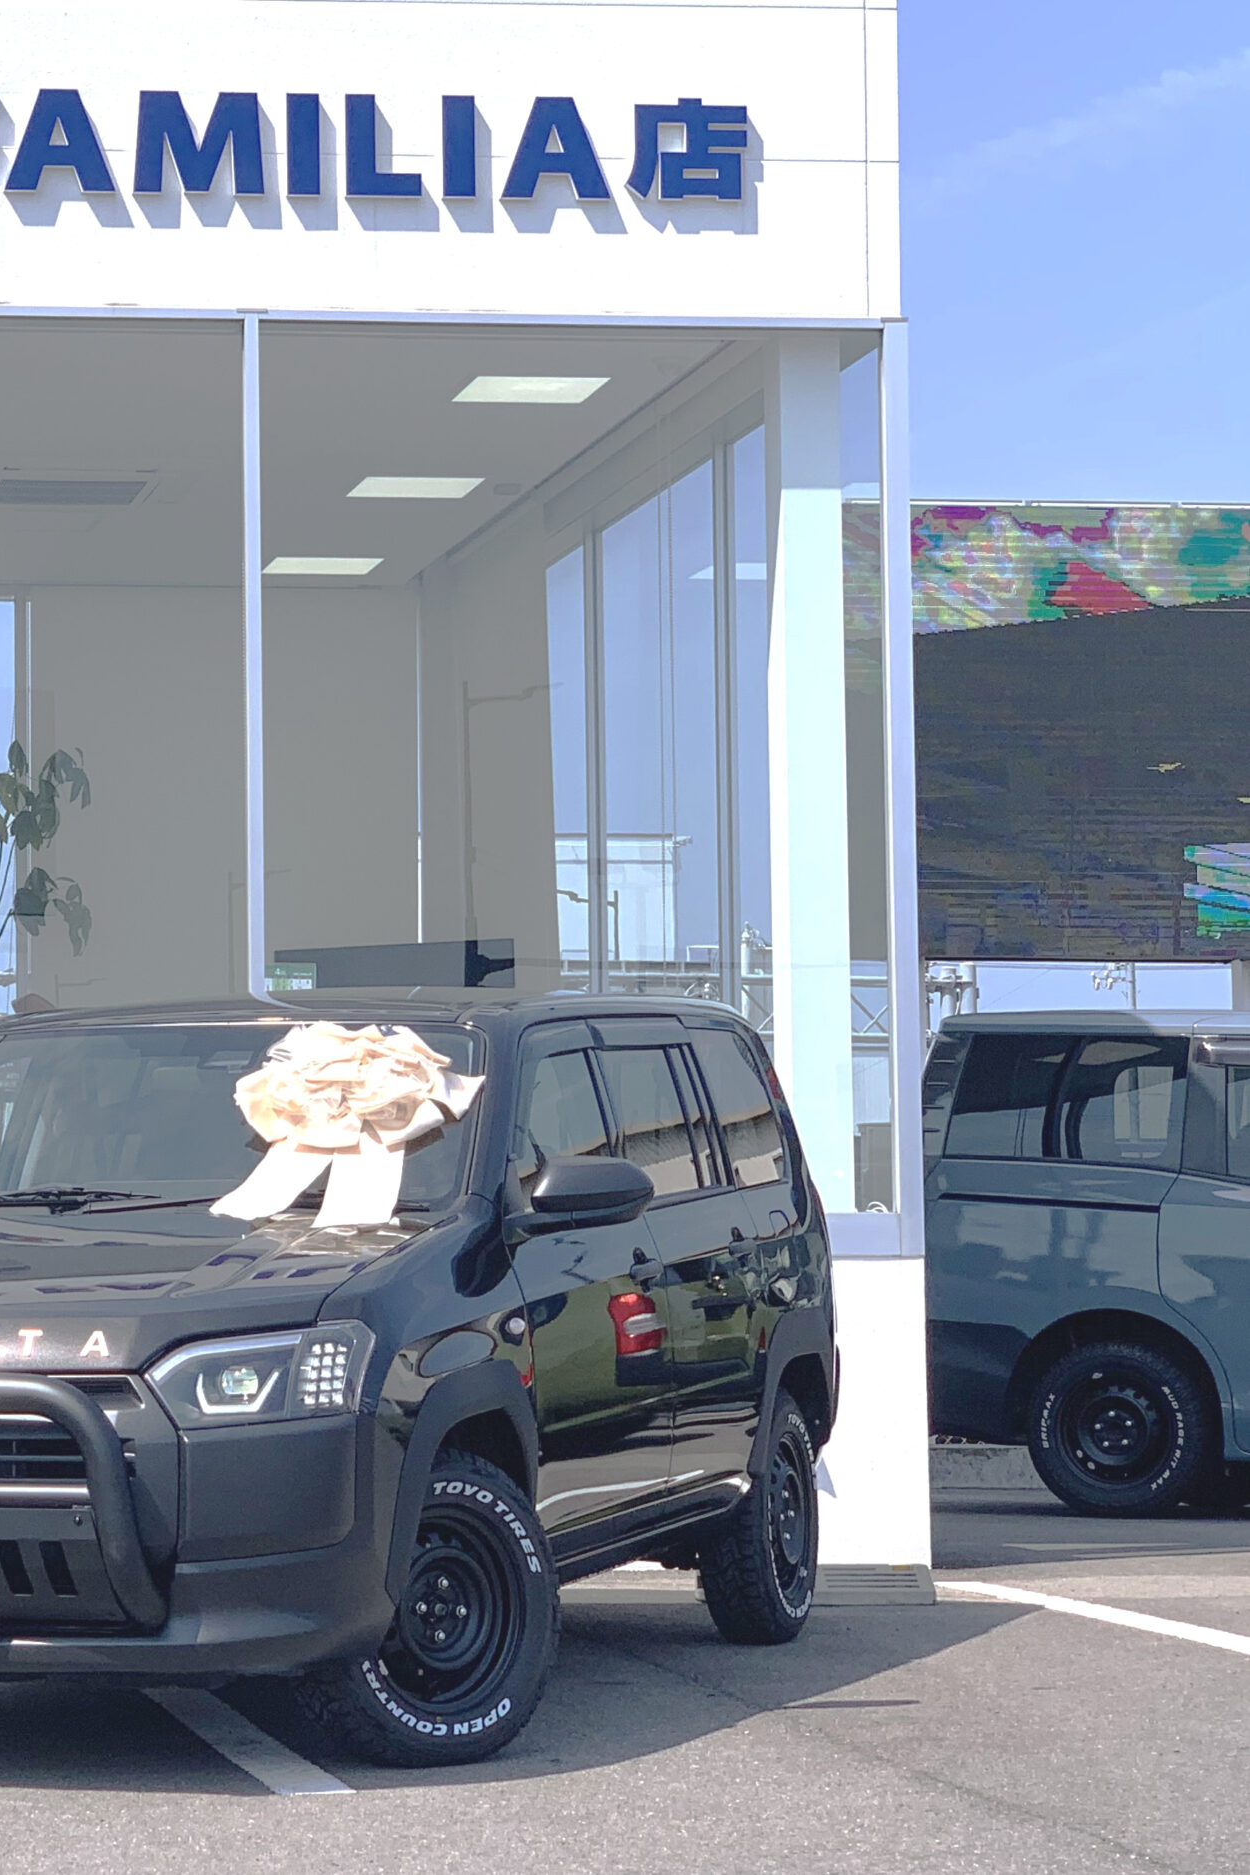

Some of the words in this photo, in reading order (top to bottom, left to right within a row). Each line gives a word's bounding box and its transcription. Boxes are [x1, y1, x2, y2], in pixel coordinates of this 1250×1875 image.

[1161, 1386, 1180, 1409] MUD
[1174, 1411, 1186, 1447] RAGE
[1150, 1469, 1170, 1491] MAX
[432, 1480, 495, 1505] TOYO
[493, 1500, 543, 1575] TIRES
[453, 1697, 512, 1736] OPEN
